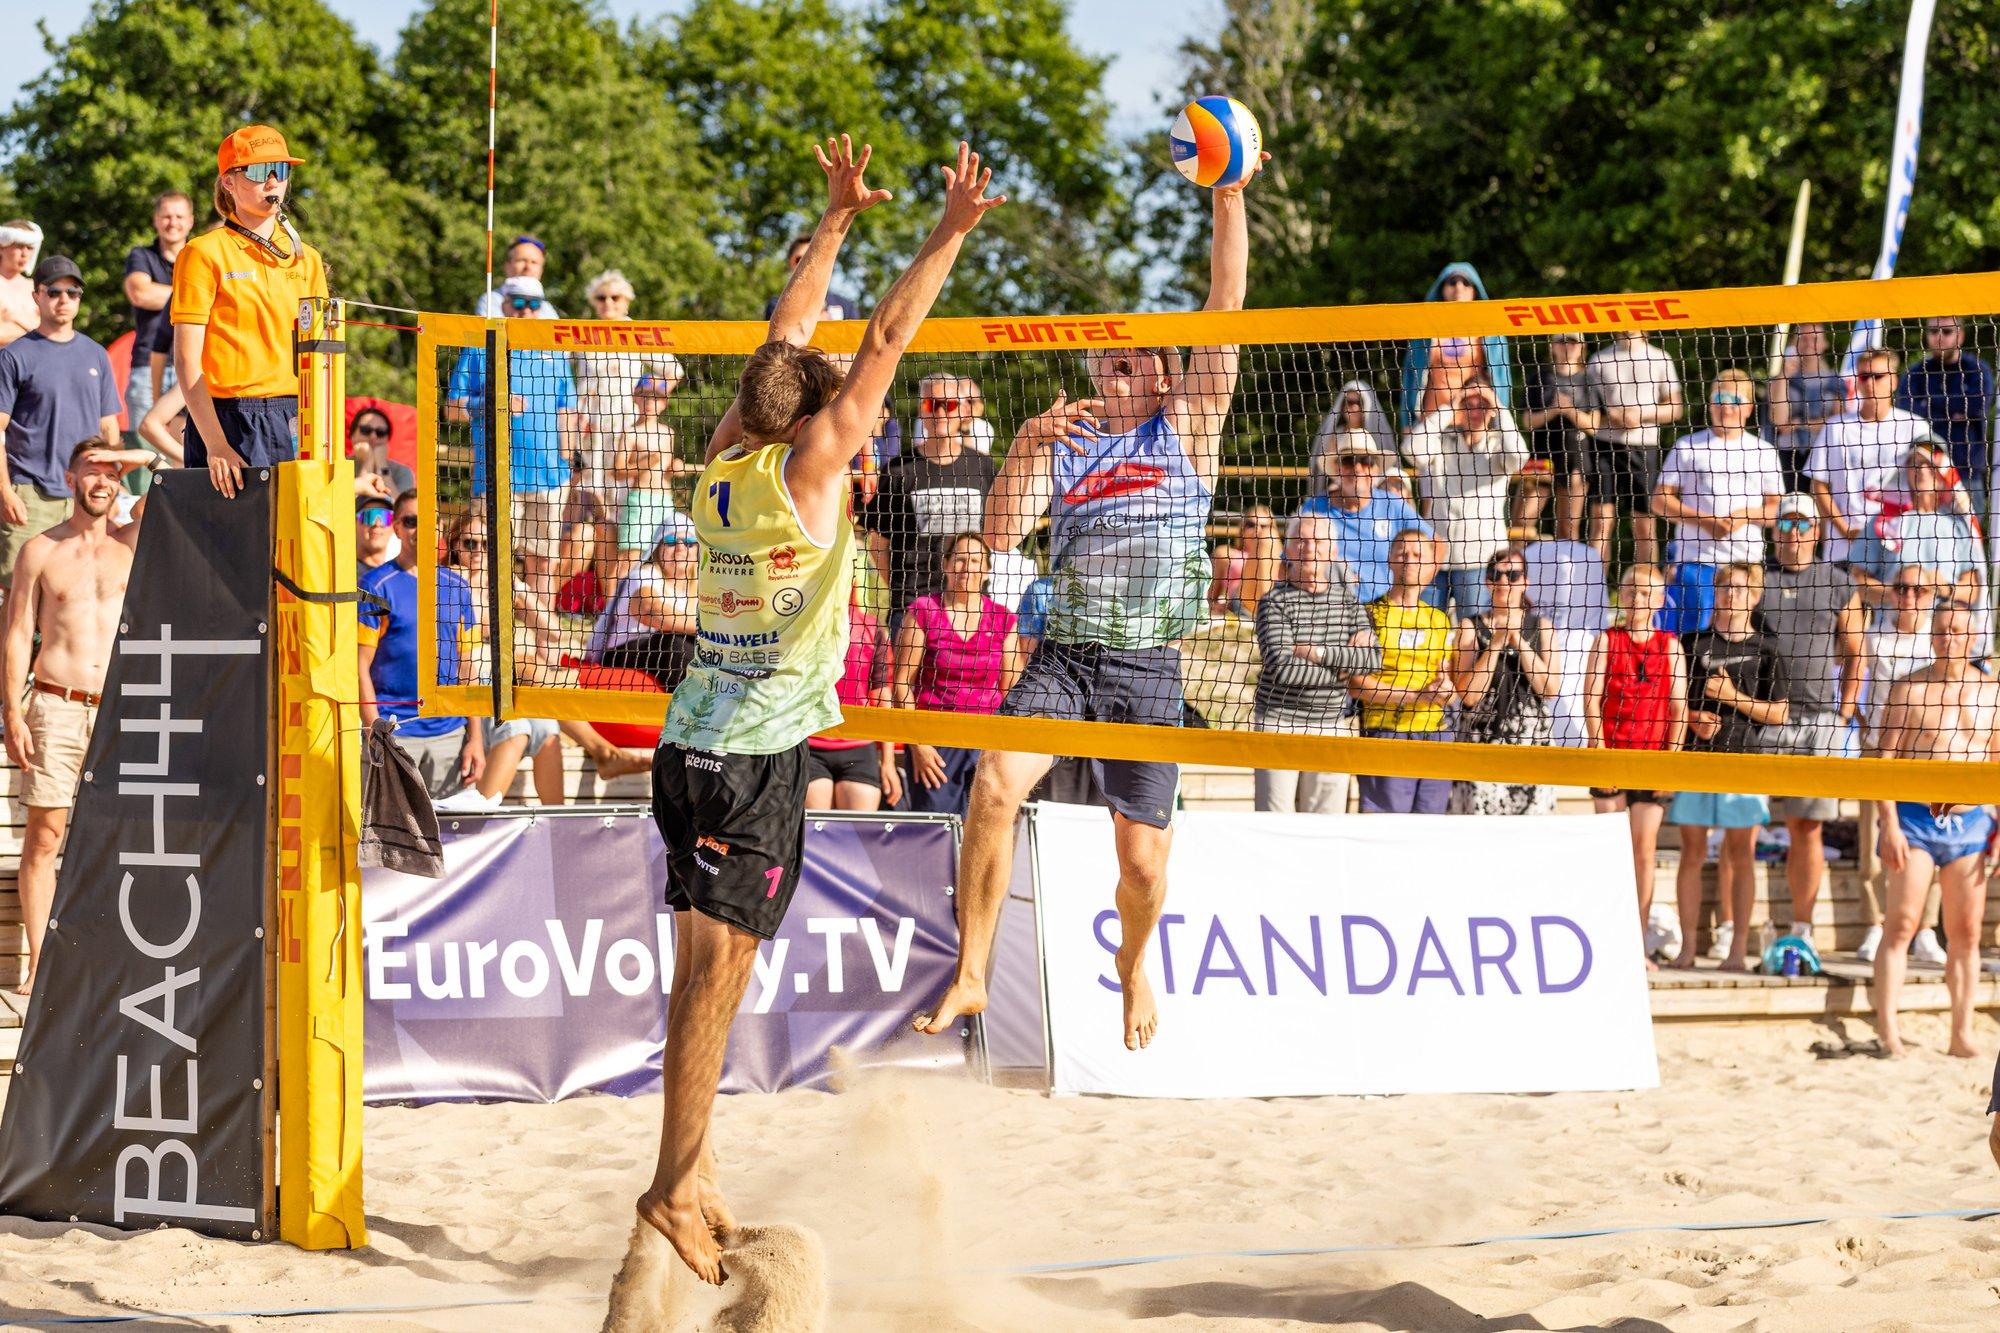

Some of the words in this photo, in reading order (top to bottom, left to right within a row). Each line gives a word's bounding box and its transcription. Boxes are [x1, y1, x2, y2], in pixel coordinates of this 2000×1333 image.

[1503, 299, 1690, 327] FUNTEC
[554, 325, 675, 347] FUNTEC
[981, 321, 1133, 344] FUNTEC
[709, 481, 731, 527] 1
[709, 547, 754, 566] ŠKODA
[709, 566, 754, 576] RAKVERE
[729, 650, 780, 664] BABE
[276, 539, 302, 964] FUNTEC
[765, 866, 784, 899] 1
